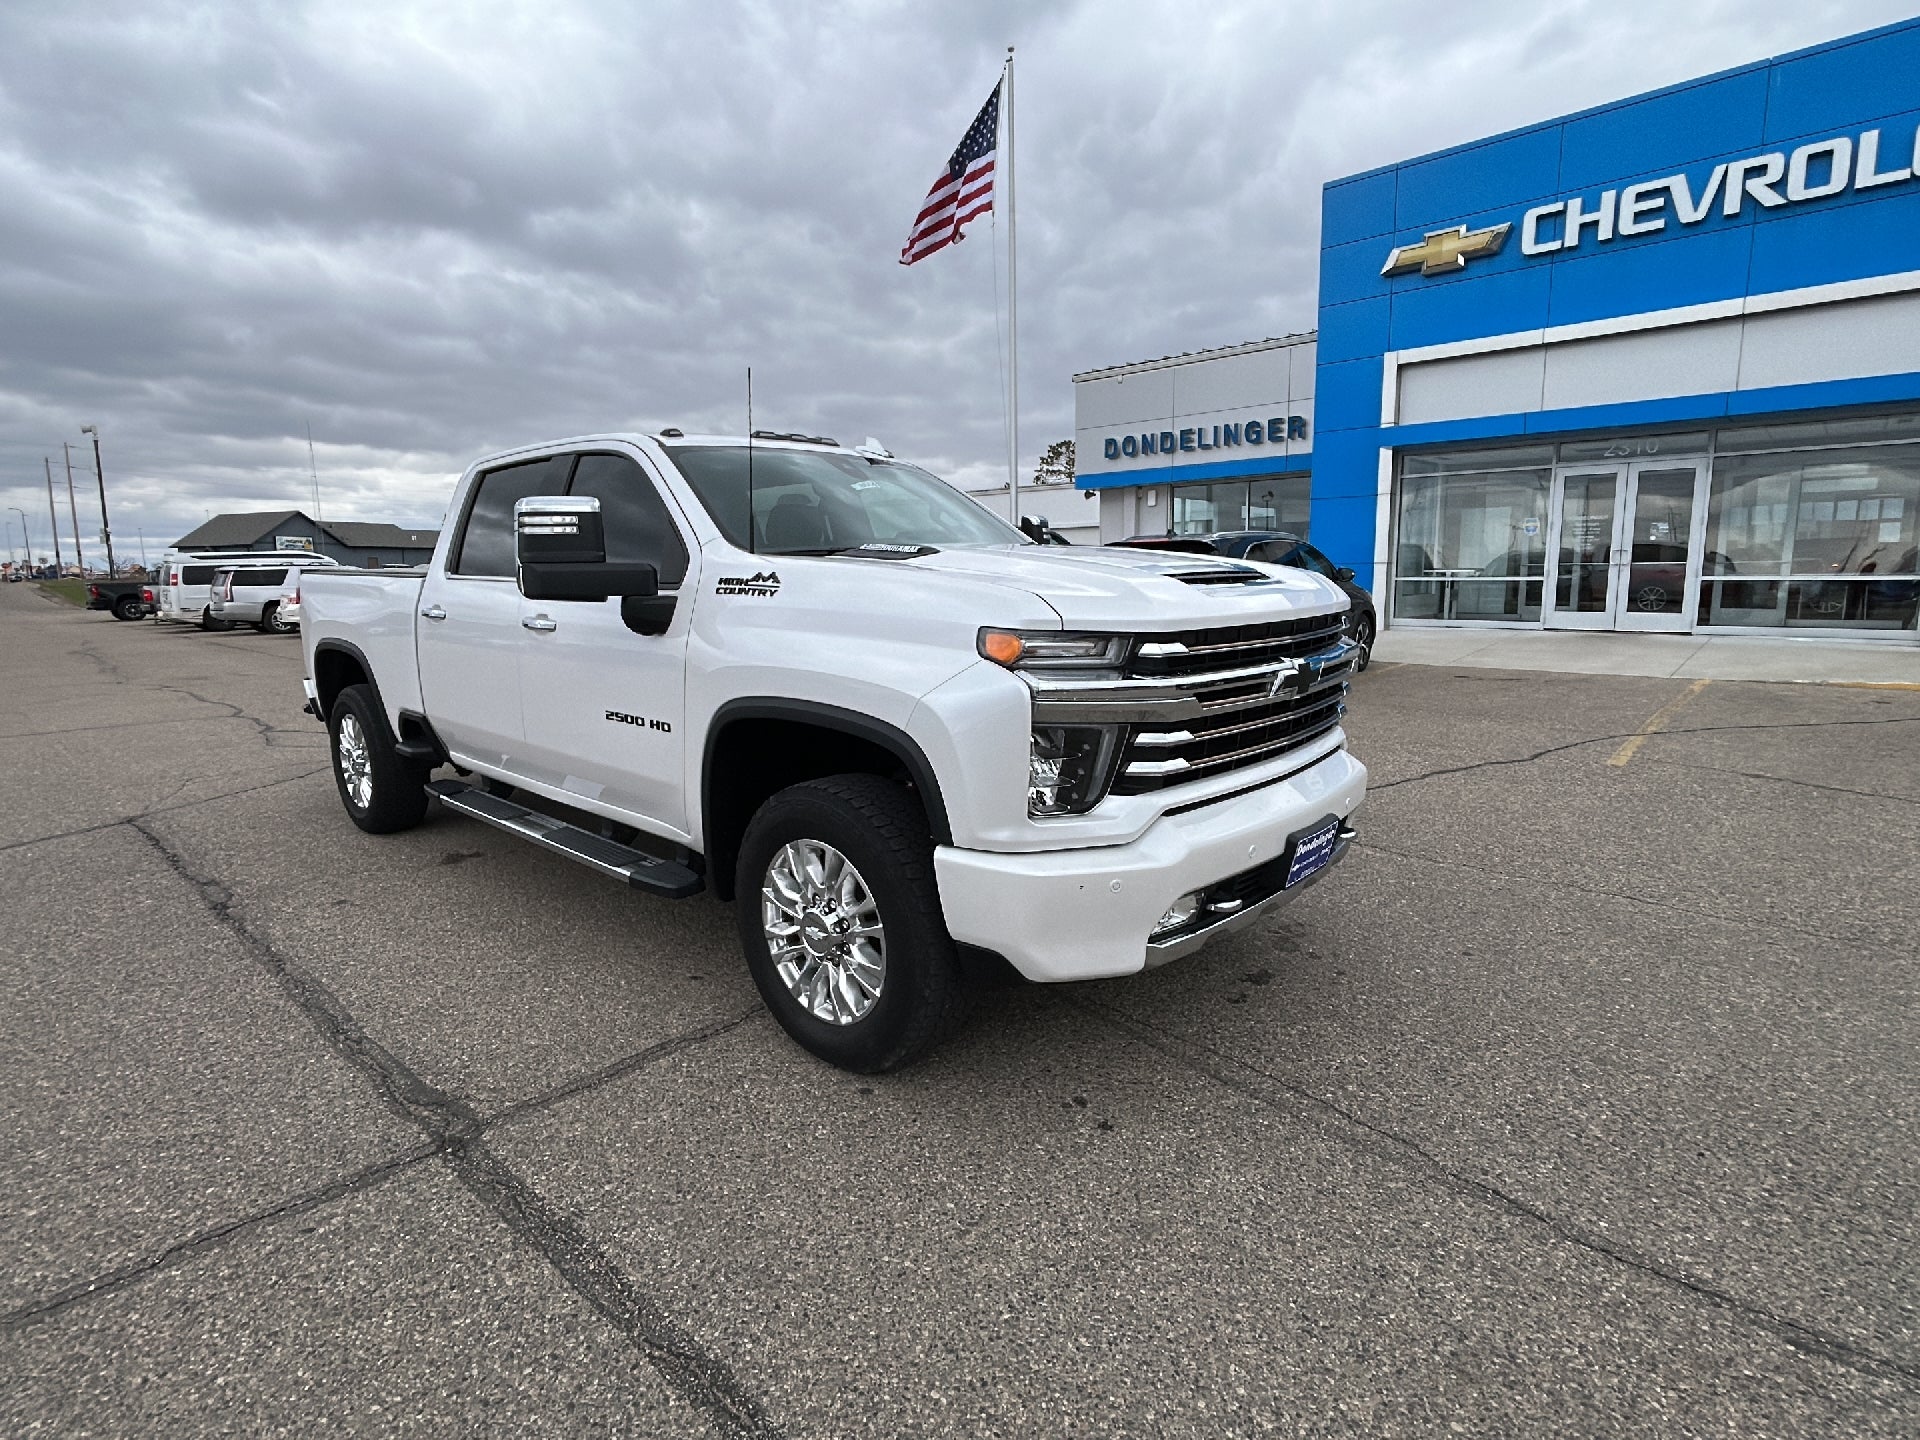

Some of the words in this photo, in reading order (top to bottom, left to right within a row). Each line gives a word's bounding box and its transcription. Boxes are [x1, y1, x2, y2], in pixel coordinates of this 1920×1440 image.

[1521, 125, 1920, 255] CHEVROL
[1104, 415, 1307, 460] DONDELINGER
[716, 587, 778, 597] COUNTRY
[718, 577, 747, 586] HIGH
[605, 710, 645, 727] 2500
[649, 719, 671, 733] HD
